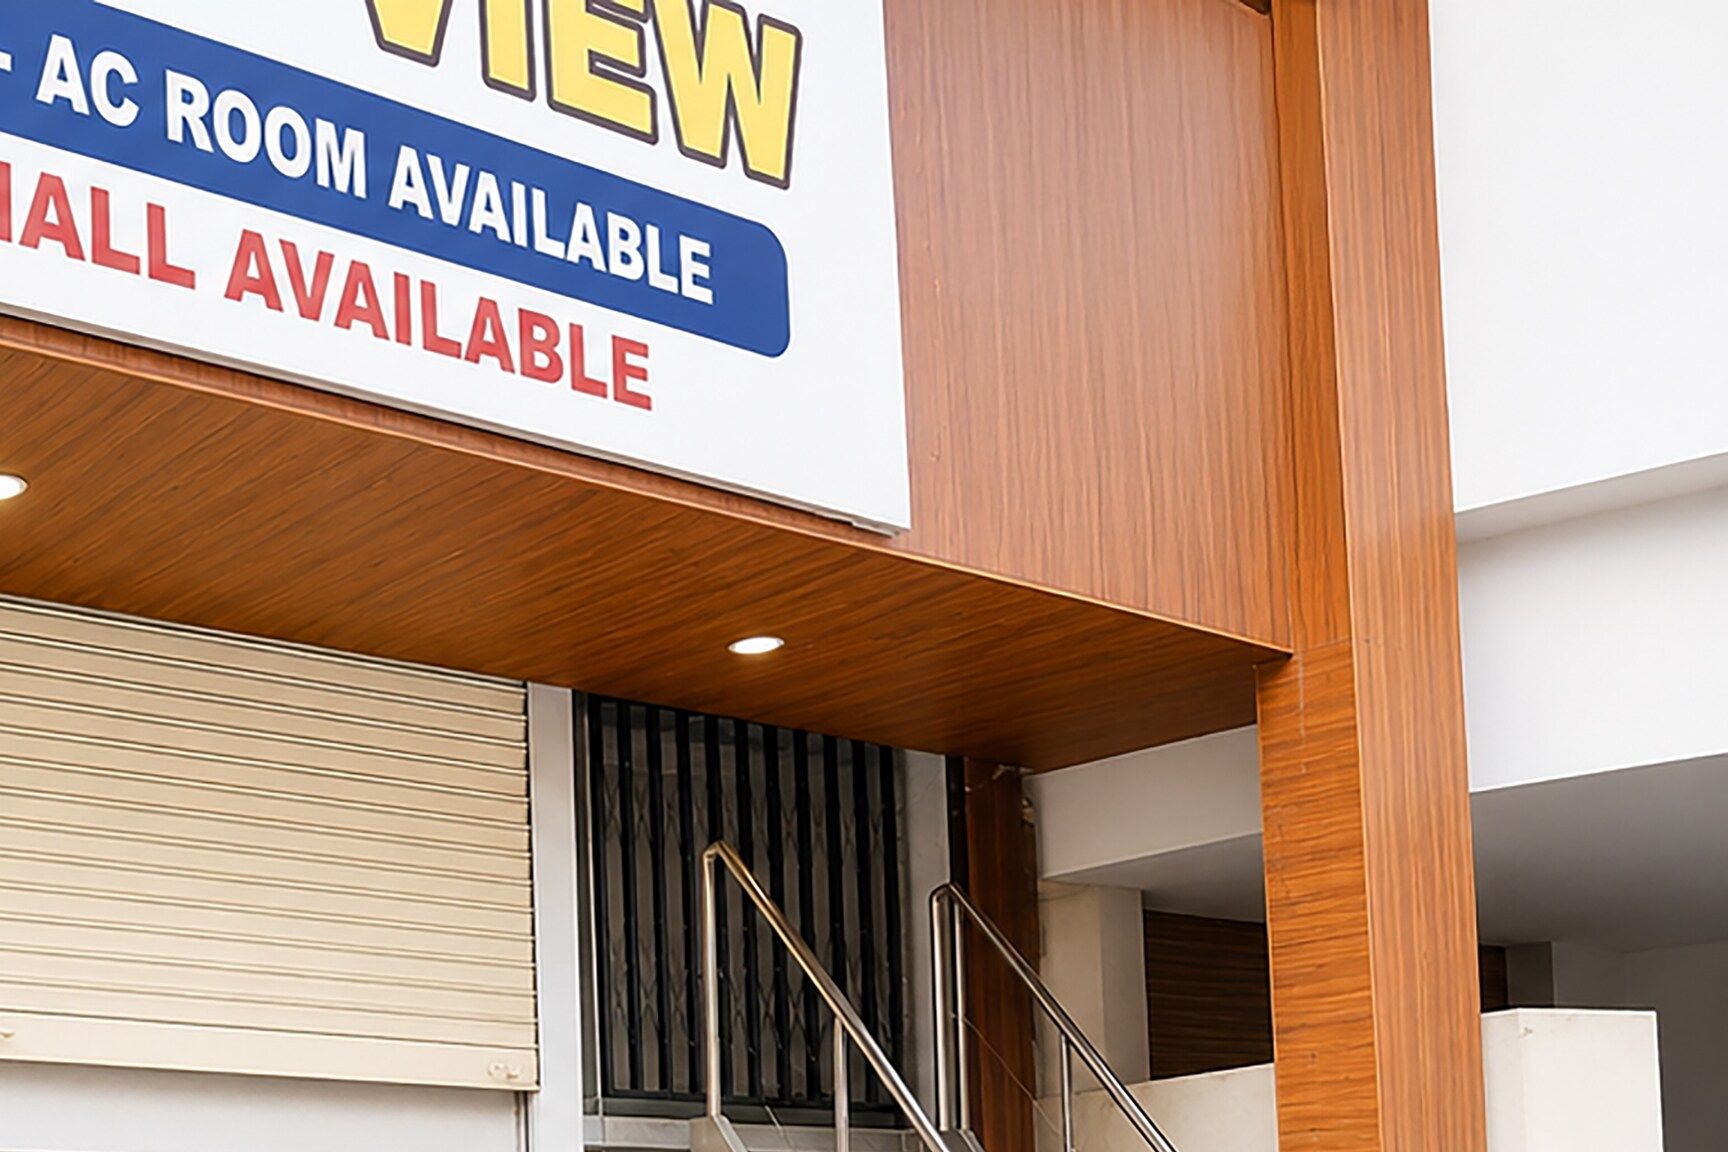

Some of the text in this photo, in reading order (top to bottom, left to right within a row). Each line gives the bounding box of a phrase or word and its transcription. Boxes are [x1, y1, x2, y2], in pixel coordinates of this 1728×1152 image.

[35, 34, 140, 127] AC
[165, 69, 367, 199] ROOM
[388, 145, 715, 305] AVAILABLE
[224, 229, 652, 411] AVAILABLE
